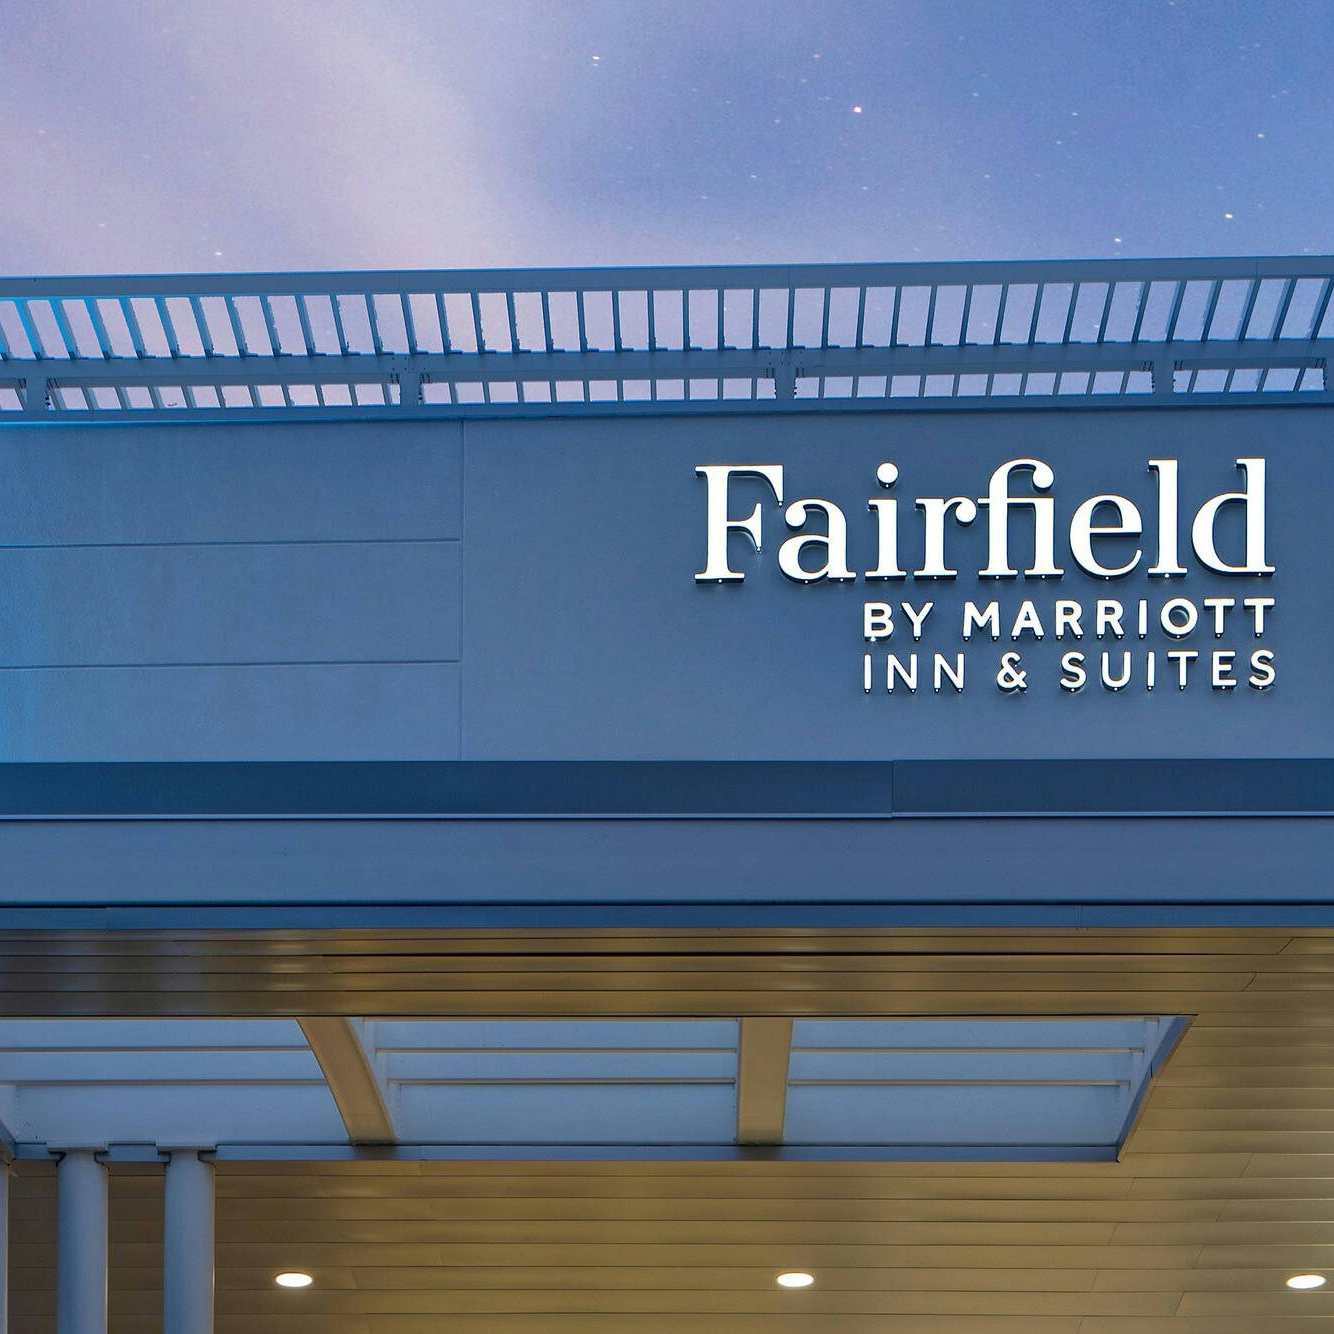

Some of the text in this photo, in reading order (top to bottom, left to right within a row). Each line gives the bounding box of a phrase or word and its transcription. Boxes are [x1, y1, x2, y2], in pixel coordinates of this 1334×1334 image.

[694, 457, 1276, 584] Fairfield
[863, 597, 1276, 641] BY MARRIOTT
[863, 649, 1276, 693] INN & SUITES
